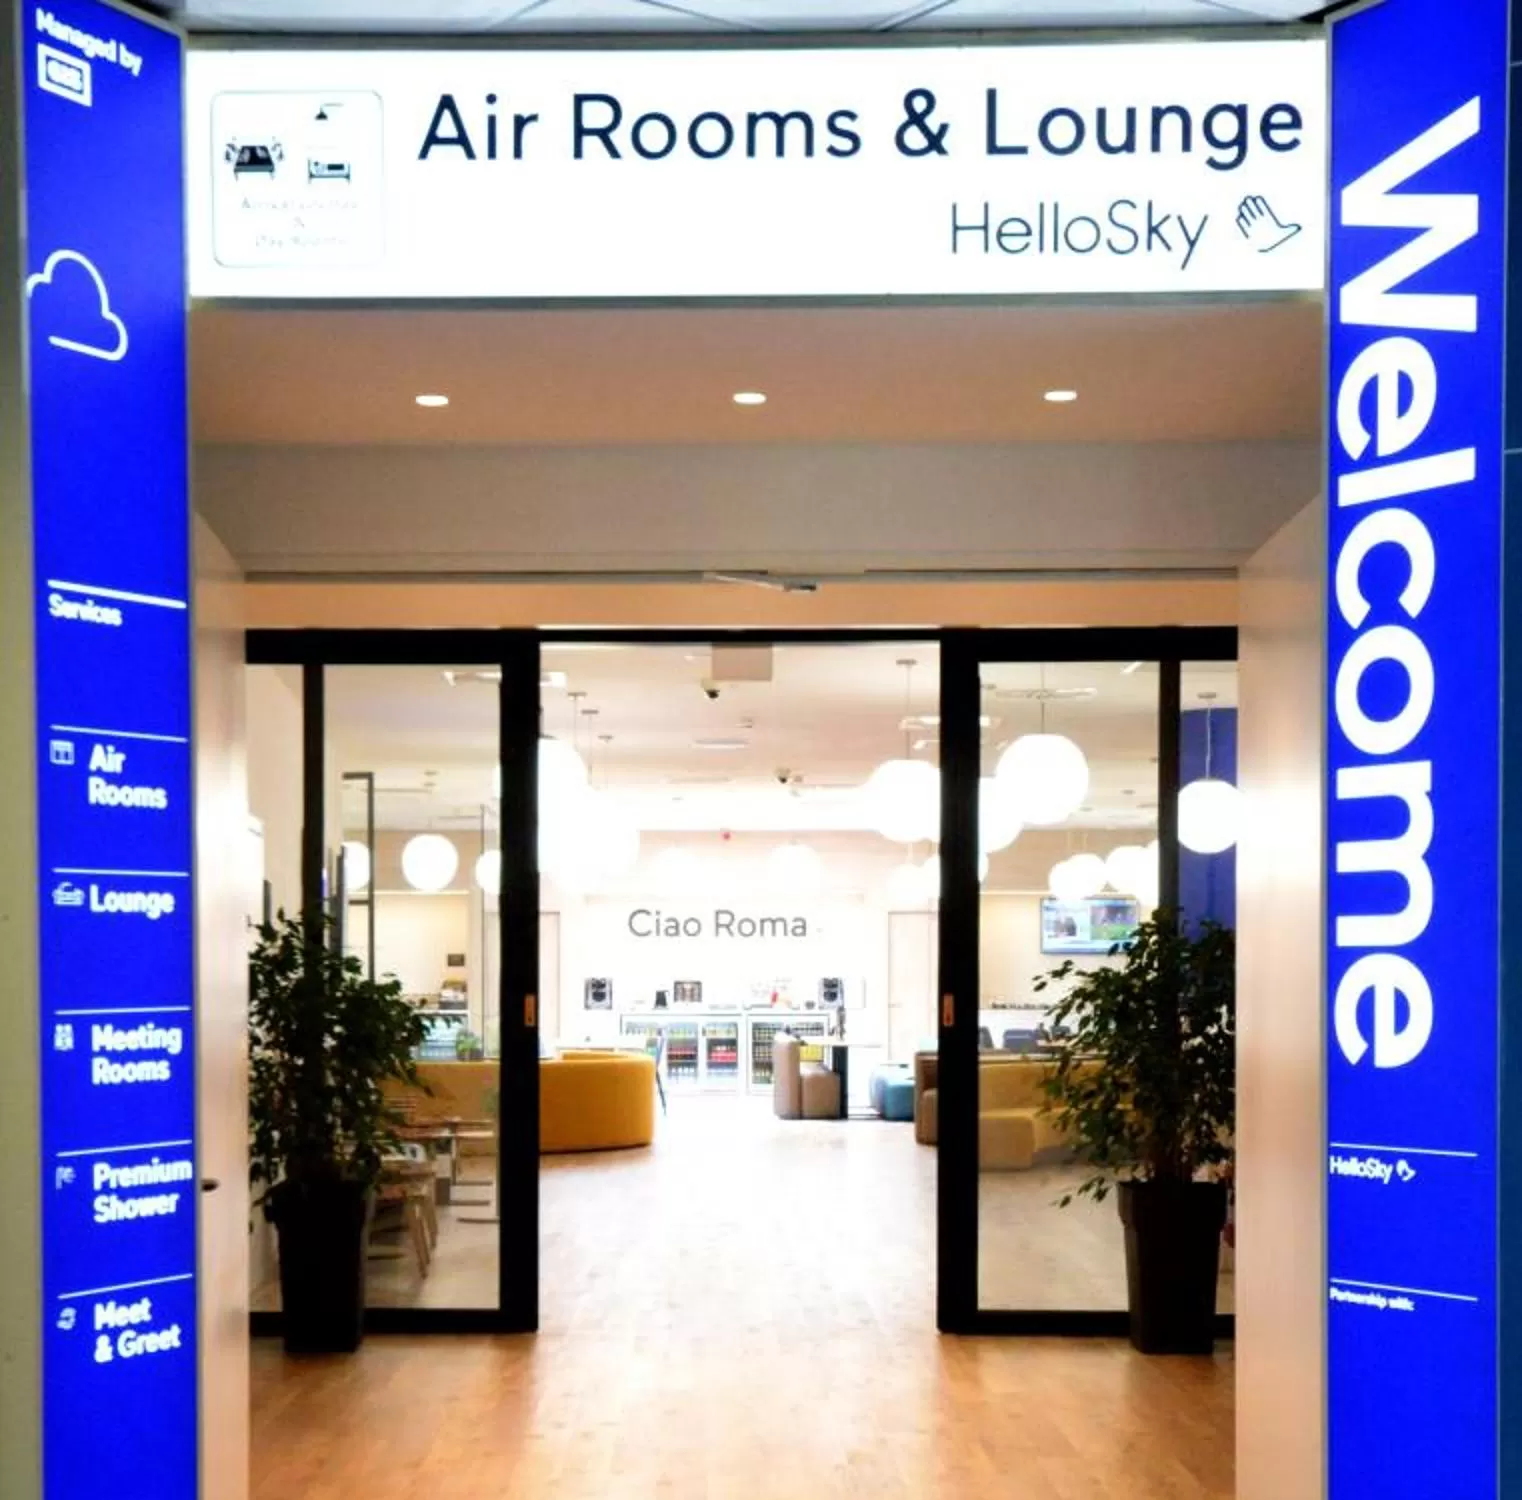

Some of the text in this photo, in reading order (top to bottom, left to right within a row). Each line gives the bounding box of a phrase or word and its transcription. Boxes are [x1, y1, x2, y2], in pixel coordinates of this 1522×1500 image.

[36, 8, 117, 63] Managed
[119, 42, 143, 77] by
[417, 87, 1303, 171] Air Rooms & Lounge
[951, 199, 1208, 271] HelloSky
[1333, 94, 1481, 1069] Welcome
[48, 593, 123, 627] Services
[88, 744, 126, 774] Air
[88, 776, 168, 810] Rooms
[89, 884, 175, 920] Lounge
[628, 909, 807, 938] Ciao Roma
[91, 1021, 182, 1055] Meeting
[91, 1057, 171, 1086] Rooms
[92, 1157, 193, 1191] Premium
[92, 1192, 179, 1224] Shower
[94, 1297, 151, 1330] Meet
[94, 1324, 181, 1363] & Greet
